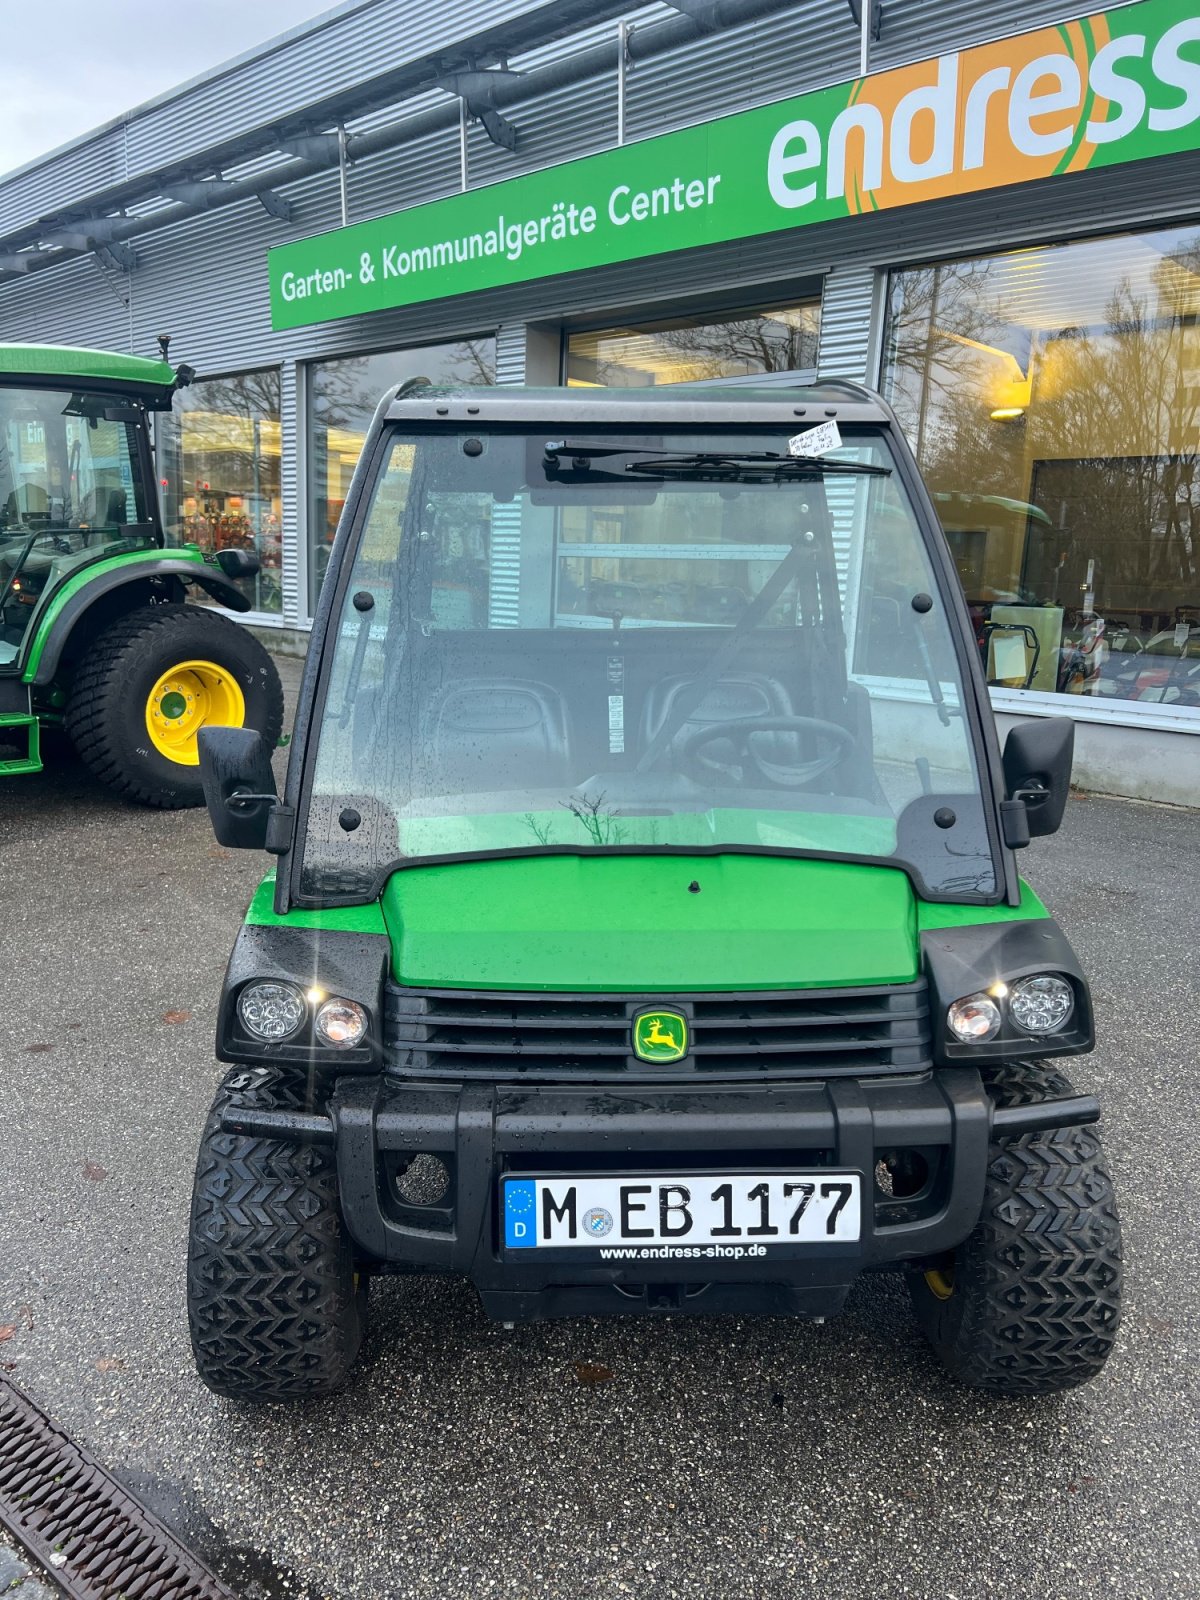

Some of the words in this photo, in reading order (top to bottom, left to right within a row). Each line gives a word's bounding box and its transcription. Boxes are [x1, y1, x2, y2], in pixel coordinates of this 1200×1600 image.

[768, 17, 1200, 208] endress
[281, 266, 353, 301] Garten-
[359, 253, 376, 284] &
[383, 202, 597, 279] Kommunalgeräte
[608, 174, 721, 226] Center
[514, 1222, 527, 1237] D
[542, 1187, 577, 1240] M
[620, 1184, 693, 1238] EB
[710, 1183, 852, 1236] 1177
[600, 1244, 767, 1260] www.endress-shop.de
